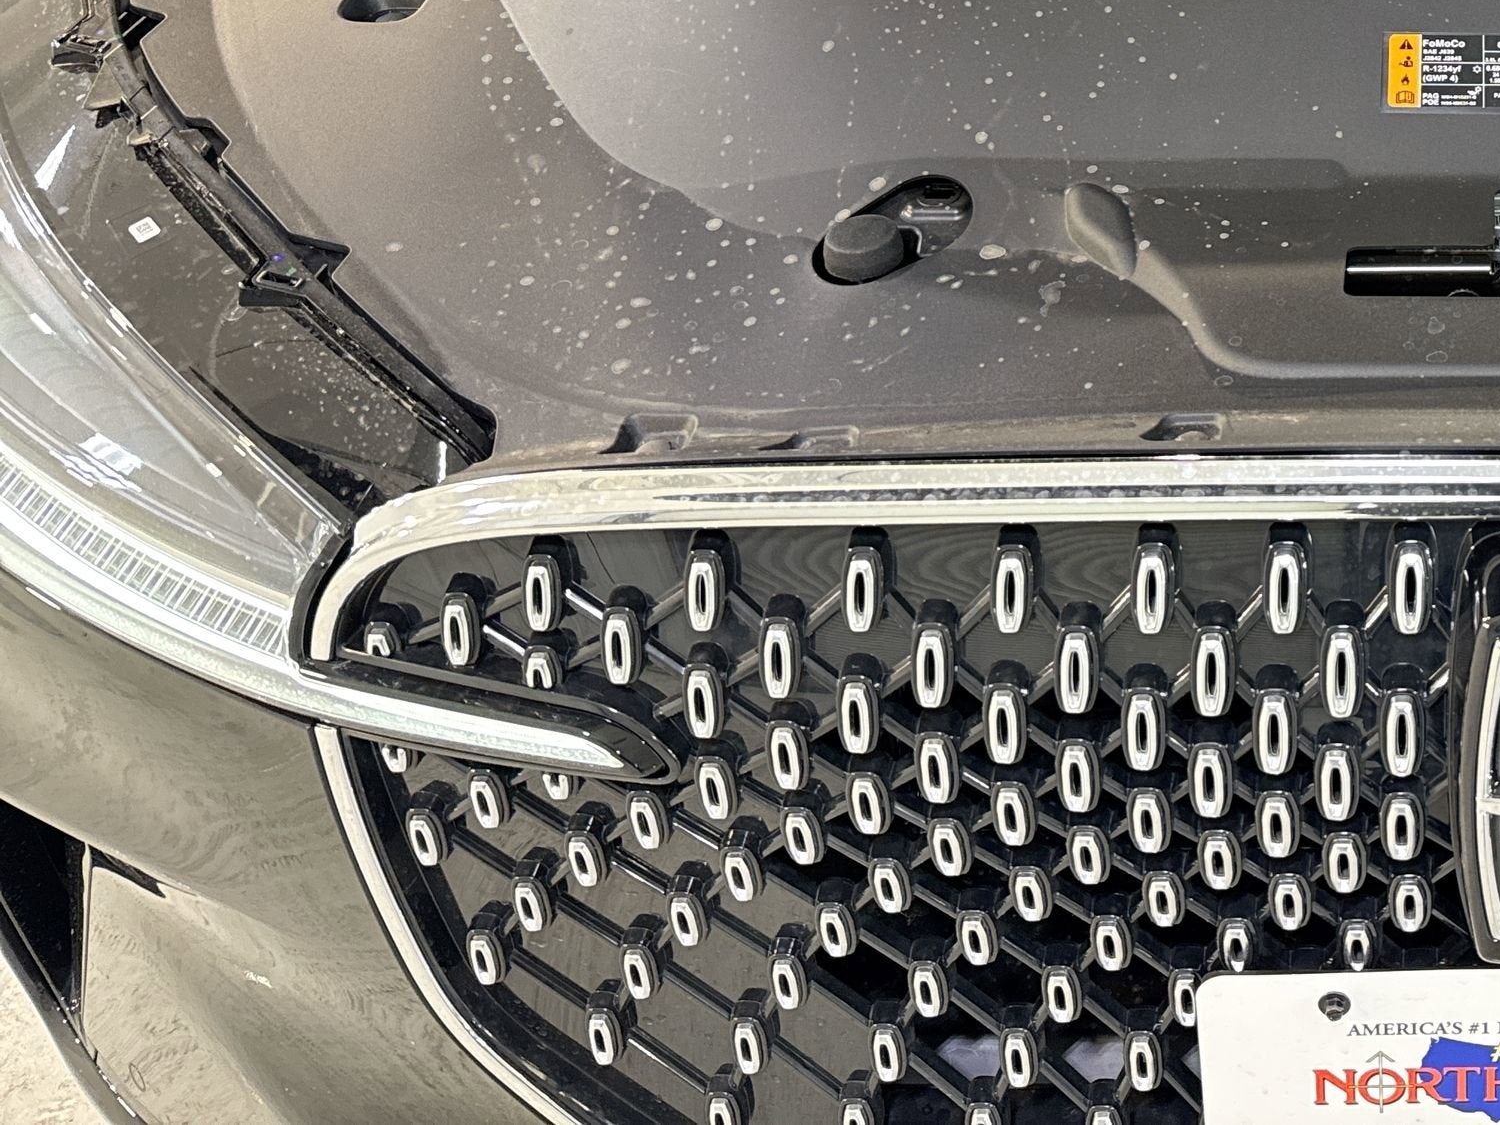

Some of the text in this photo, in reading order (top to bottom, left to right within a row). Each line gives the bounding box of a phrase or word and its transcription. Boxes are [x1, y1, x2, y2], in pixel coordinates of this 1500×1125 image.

[1422, 39, 1466, 48] FoMoCo
[1422, 65, 1462, 74] R-1234yf
[1422, 74, 1459, 83] (GWP 4)
[1422, 98, 1440, 106] POE
[1346, 1021, 1463, 1037] AMERICA'S
[1468, 1021, 1490, 1035] #1
